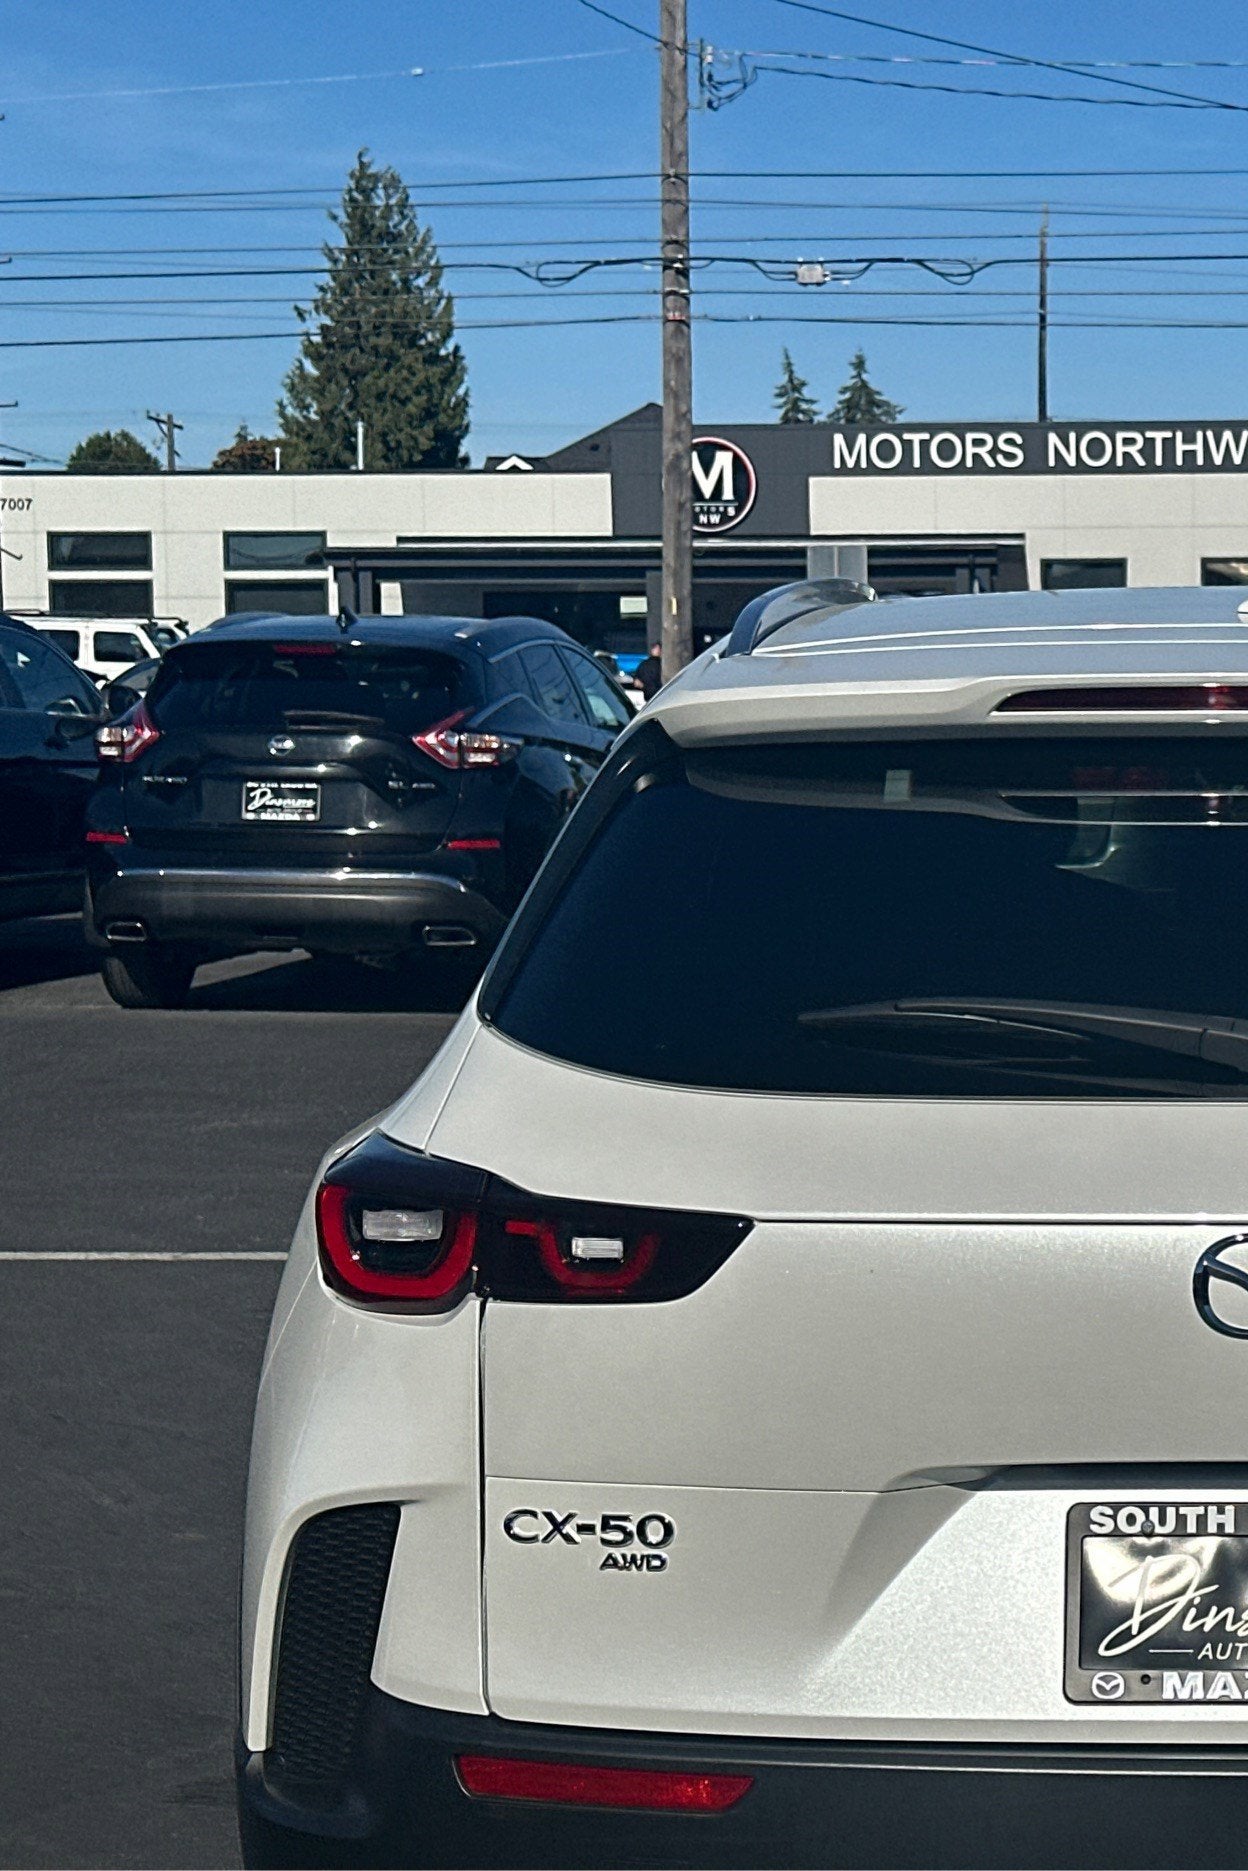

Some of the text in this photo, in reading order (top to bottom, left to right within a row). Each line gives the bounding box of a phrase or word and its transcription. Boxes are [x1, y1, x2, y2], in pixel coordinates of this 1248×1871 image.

[833, 432, 1024, 469] MOTORS
[692, 450, 735, 501] M
[0, 497, 33, 511] 7007
[699, 513, 721, 525] NW
[503, 1508, 676, 1550] CX-50
[1089, 1505, 1236, 1535] SOUTH
[599, 1552, 668, 1573] AWD
